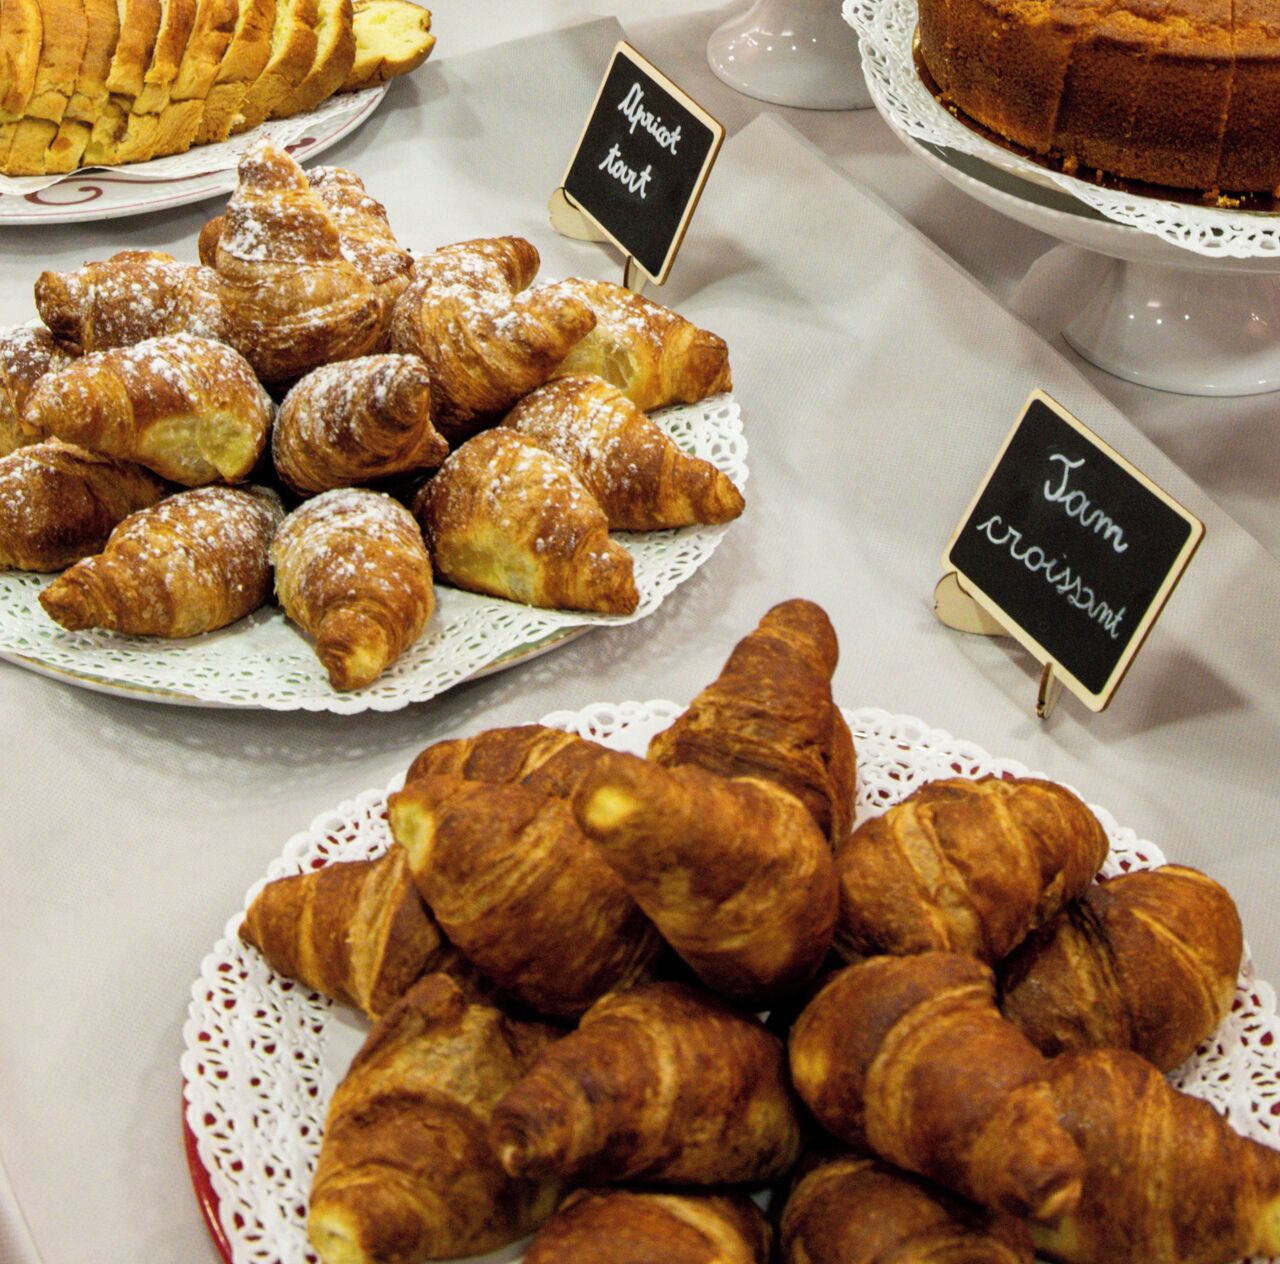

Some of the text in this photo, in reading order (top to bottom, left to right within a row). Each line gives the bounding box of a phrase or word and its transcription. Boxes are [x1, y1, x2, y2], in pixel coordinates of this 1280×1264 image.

[617, 82, 682, 156] Apricot
[1044, 453, 1129, 554] Jam
[976, 515, 1127, 640] croissant
